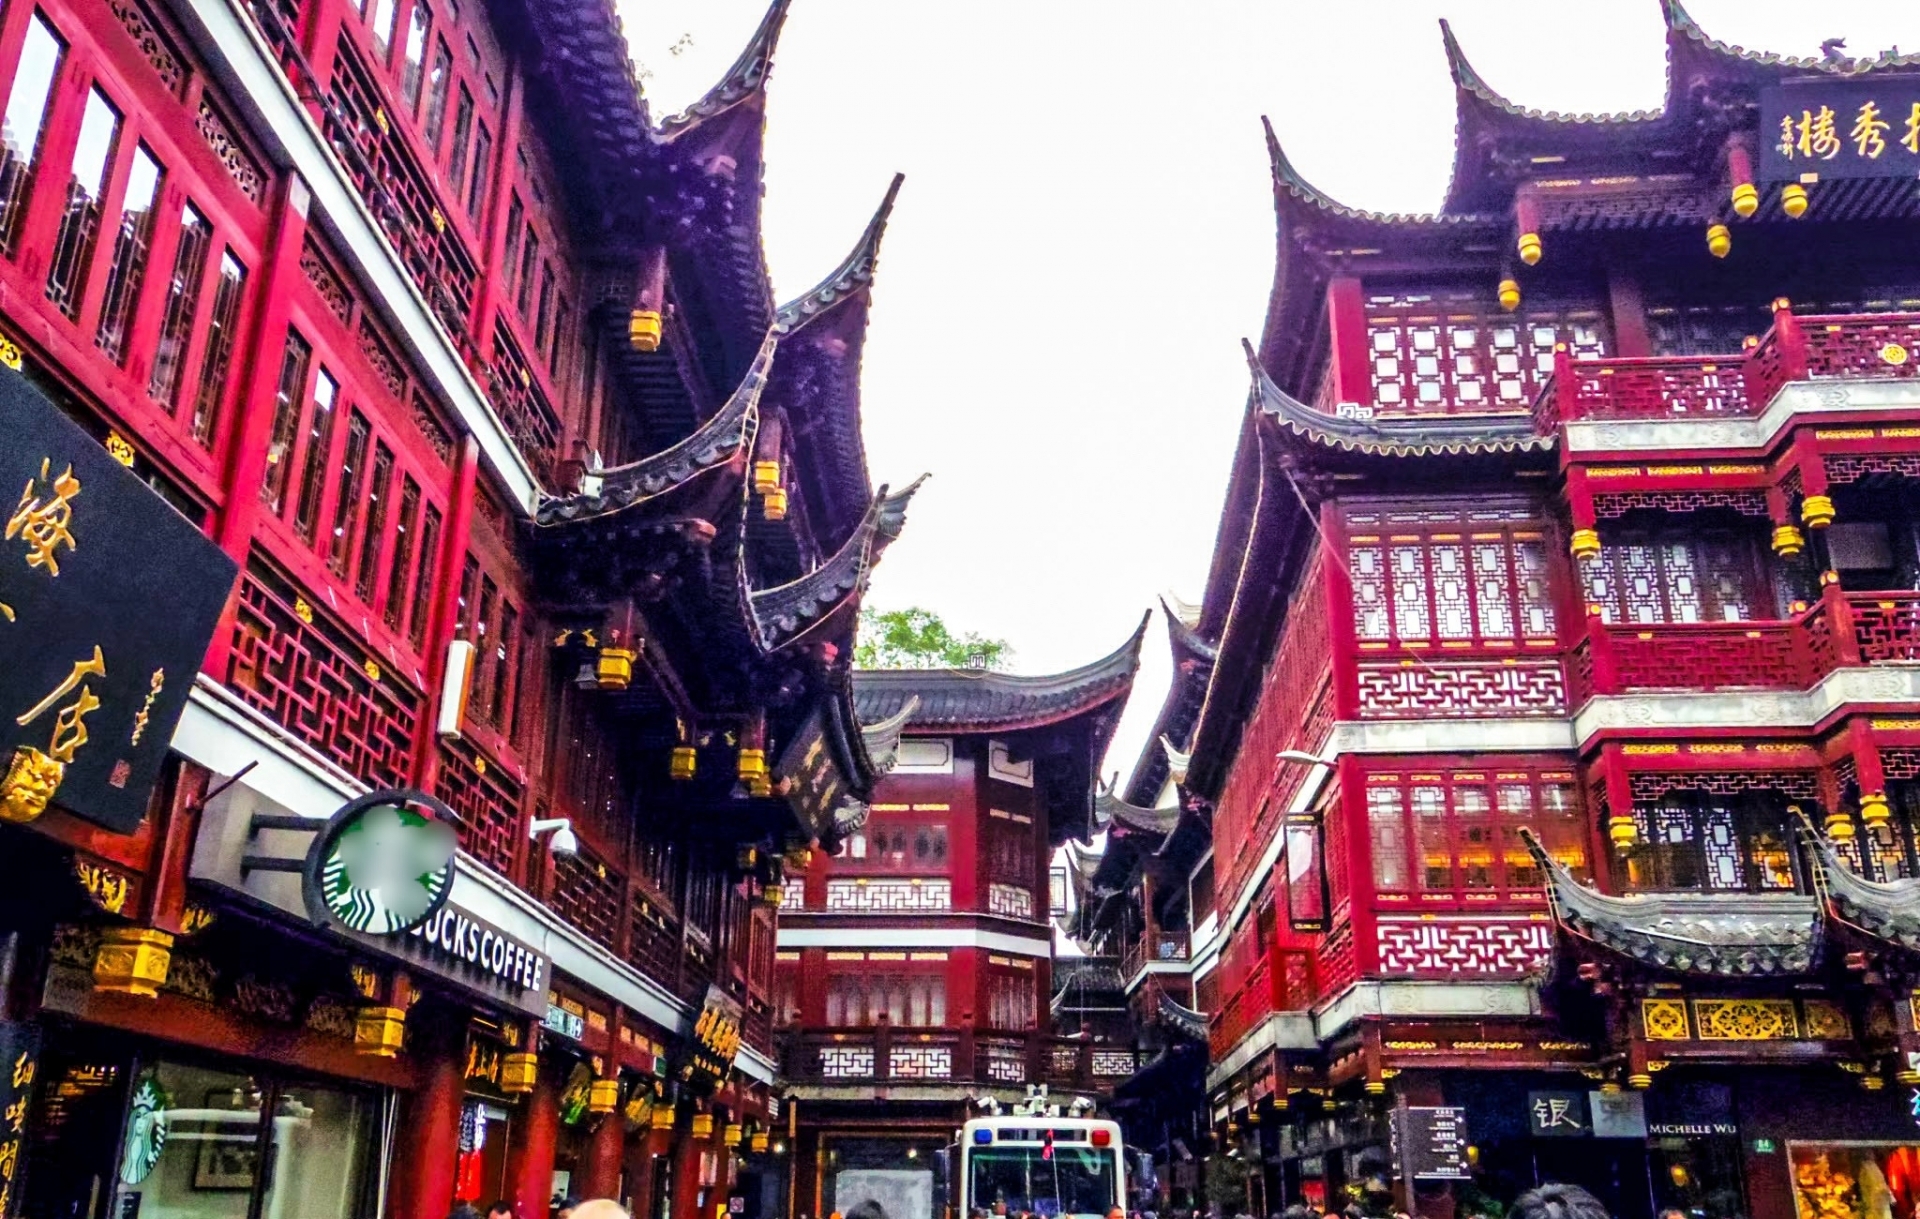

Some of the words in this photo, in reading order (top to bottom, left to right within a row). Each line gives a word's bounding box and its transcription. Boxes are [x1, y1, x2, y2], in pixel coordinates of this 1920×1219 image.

[410, 908, 480, 963] UCKS
[480, 929, 544, 992] COFFEE
[1533, 1098, 1580, 1128] 银
[1649, 1124, 1711, 1134] MICHELLE
